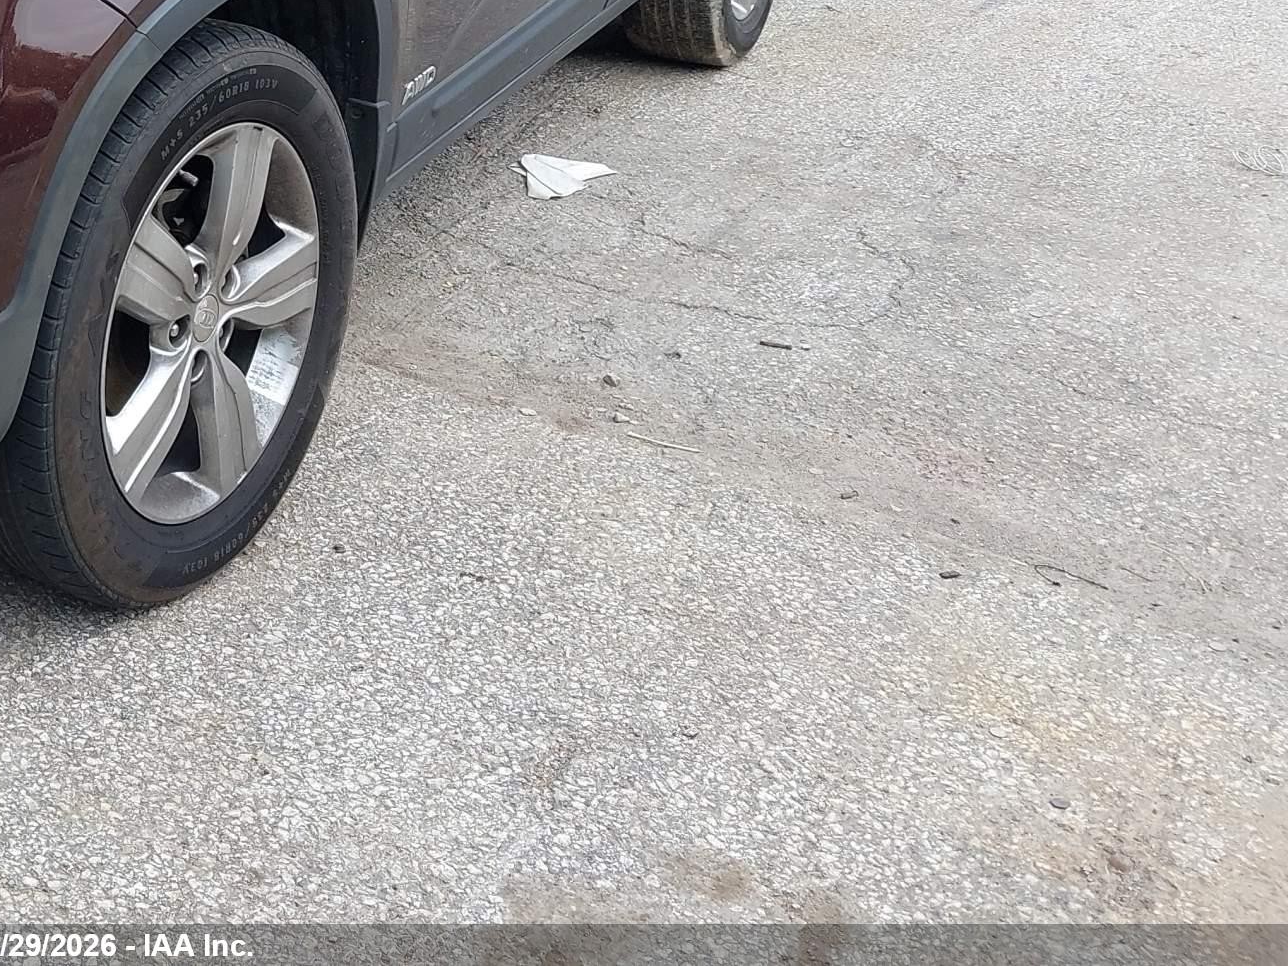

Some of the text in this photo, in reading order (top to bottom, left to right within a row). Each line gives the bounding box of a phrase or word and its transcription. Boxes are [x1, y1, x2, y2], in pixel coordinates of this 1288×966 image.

[188, 81, 250, 128] 235/60R18
[255, 78, 278, 91] 103V
[402, 66, 436, 105] AWD
